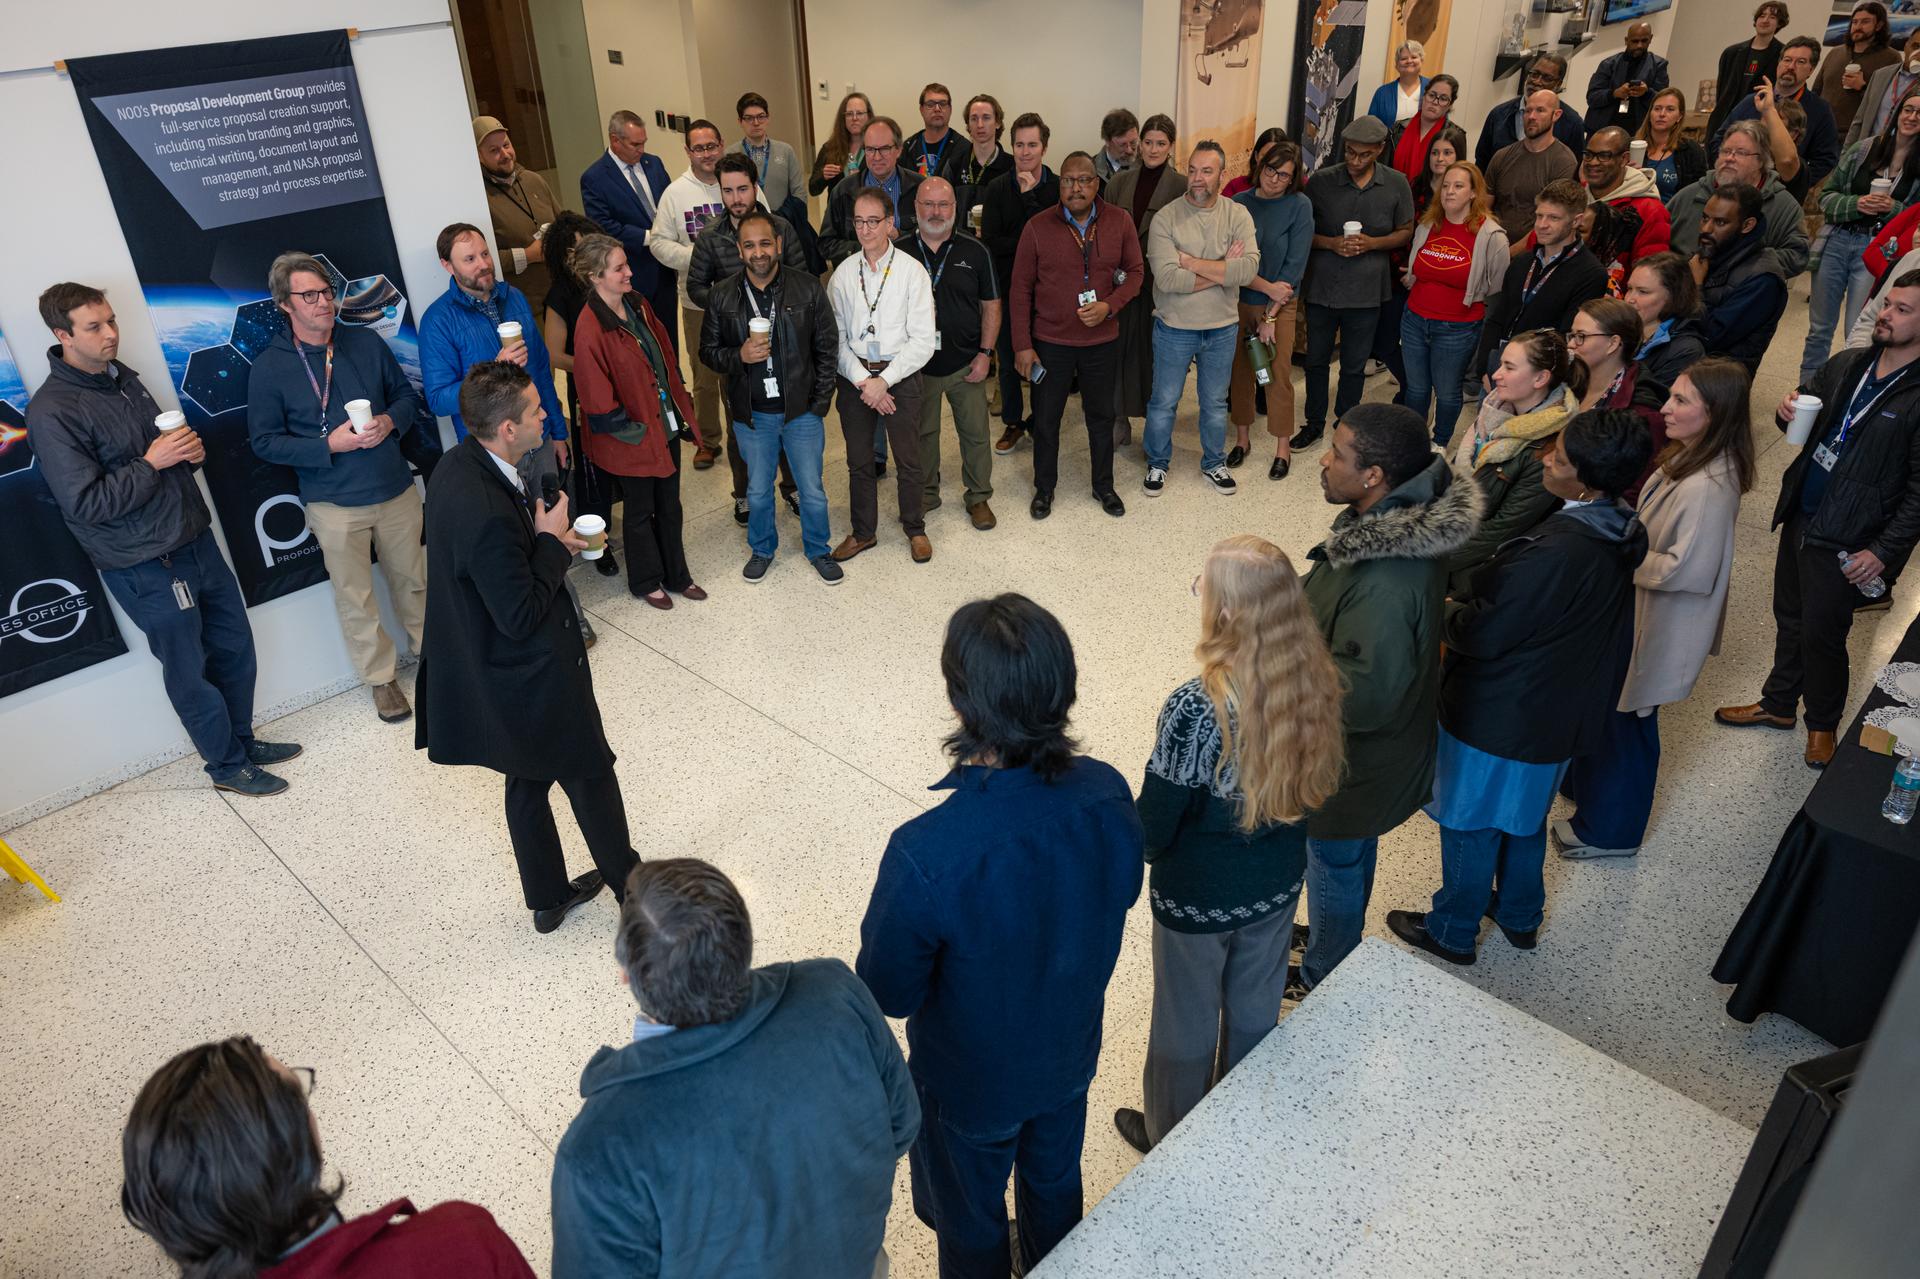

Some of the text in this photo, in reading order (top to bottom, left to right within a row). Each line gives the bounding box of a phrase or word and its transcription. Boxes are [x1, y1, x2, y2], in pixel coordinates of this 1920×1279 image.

[116, 79, 346, 121] NOO's Proposal Development Group provides
[160, 98, 351, 135] full-service proposal creation support,
[154, 116, 355, 156] including mission branding and graphics,
[169, 131, 359, 173] technical writing, document layout and
[202, 149, 363, 187] management, and NASA proposal
[218, 167, 367, 202] strategy and process expertise.
[27, 597, 88, 622] OFFICE
